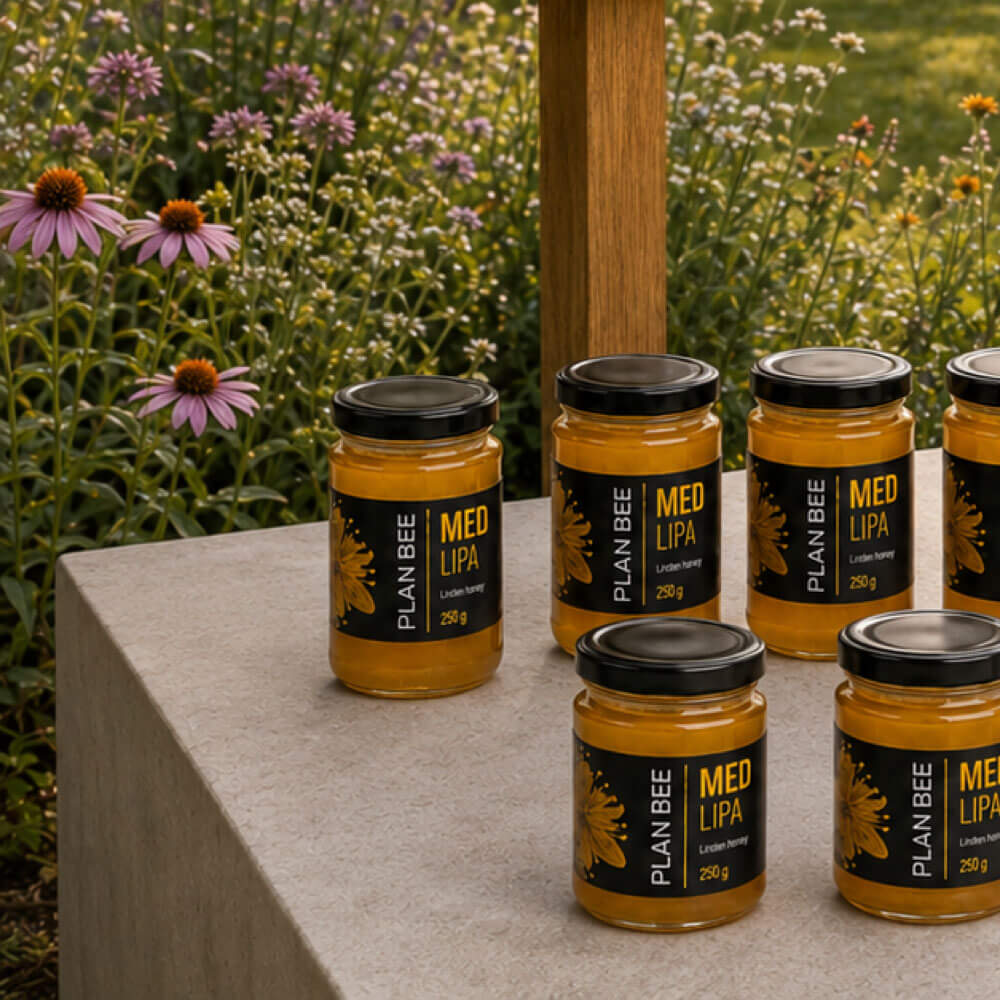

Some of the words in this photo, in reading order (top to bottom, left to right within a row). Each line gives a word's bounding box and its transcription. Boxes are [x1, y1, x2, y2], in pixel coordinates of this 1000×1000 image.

[613, 487, 632, 532] BEE
[656, 481, 705, 518] MED
[807, 479, 826, 524] BEE
[850, 473, 898, 510] MED
[397, 514, 416, 560] BEE
[440, 505, 489, 544] MED
[656, 519, 696, 552] LIPA
[850, 511, 889, 542] LIPA
[440, 544, 479, 577] LIPA
[613, 540, 632, 602] PLAN
[807, 530, 826, 593] PLAN
[397, 566, 416, 630] PLAN
[651, 768, 671, 815] BEE
[699, 758, 752, 799] MED
[912, 762, 933, 809] BEE
[699, 797, 743, 832] LIPA
[651, 821, 671, 886] PLAN
[912, 814, 933, 877] PLAN
[959, 857, 980, 874] 250
[699, 865, 720, 882] 250
